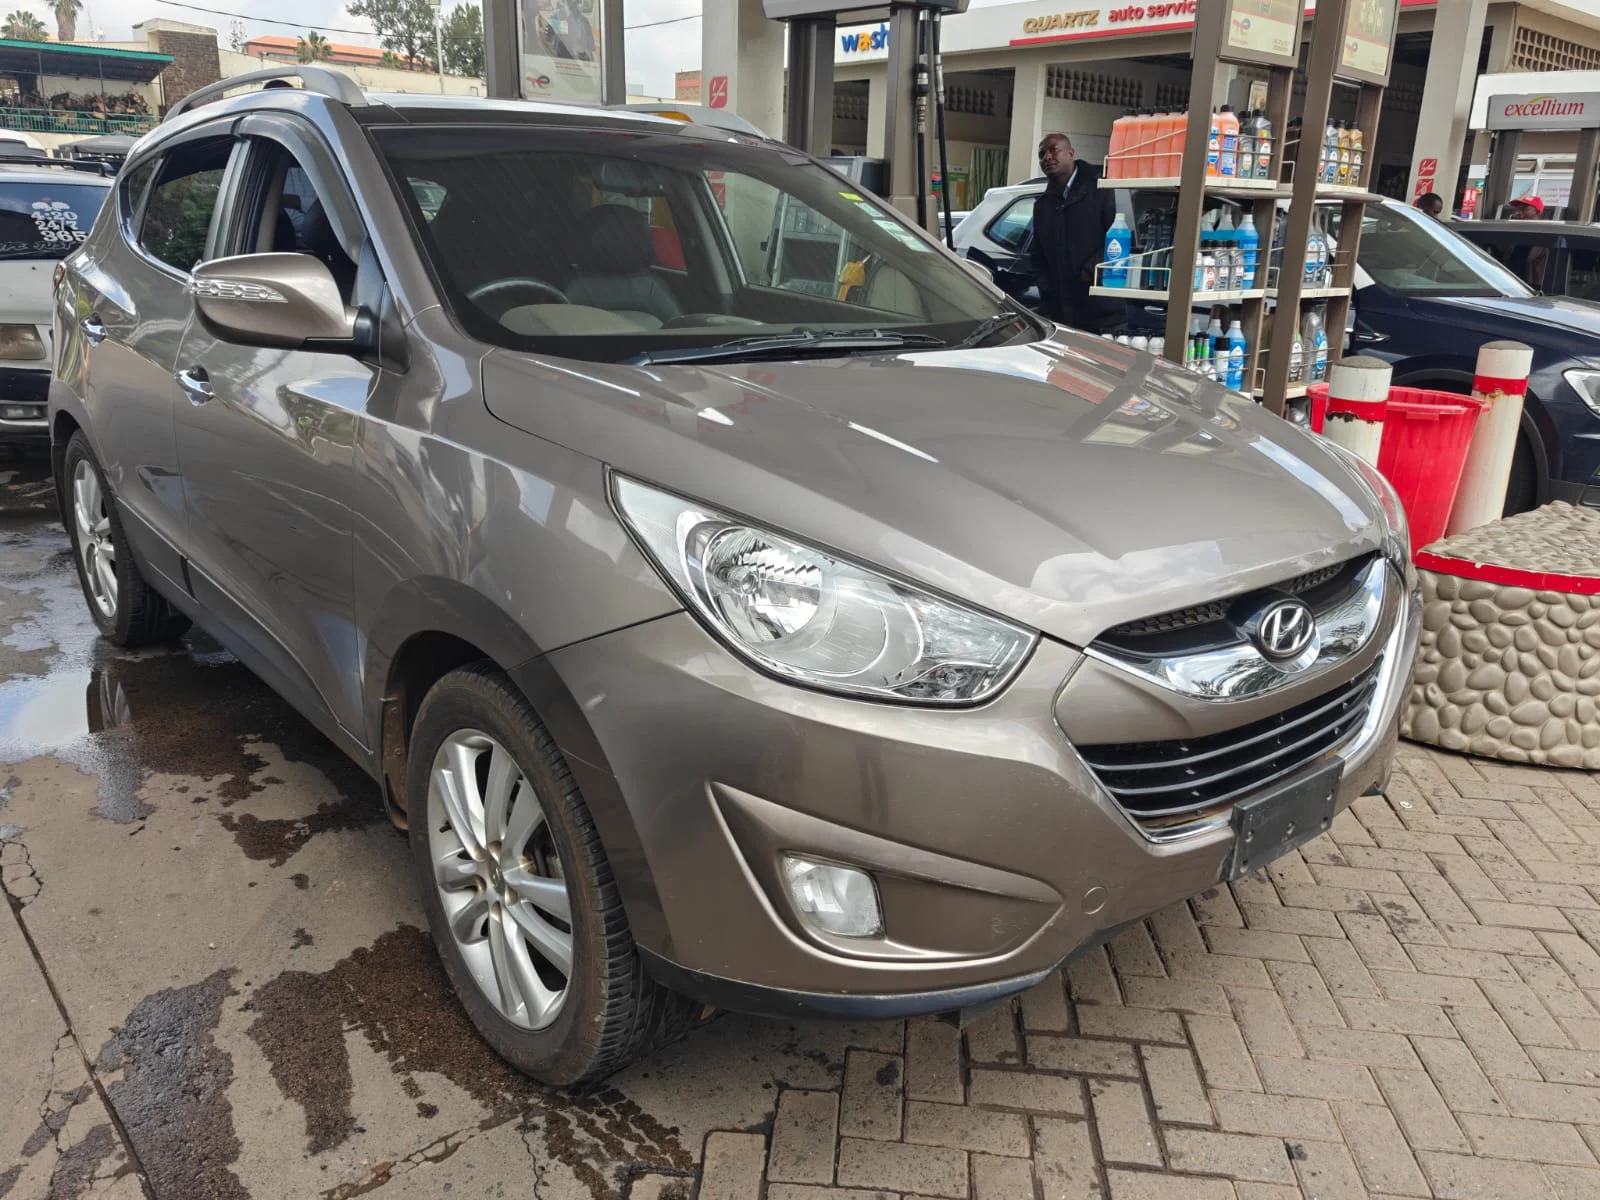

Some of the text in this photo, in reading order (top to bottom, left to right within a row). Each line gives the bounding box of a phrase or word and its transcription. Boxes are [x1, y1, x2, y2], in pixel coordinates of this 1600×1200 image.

[1023, 10, 1100, 33] QUARTZ
[1108, 6, 1144, 23] auto
[841, 23, 891, 53] wash
[1504, 99, 1584, 117] excellium
[31, 211, 78, 221] 4:20
[40, 230, 87, 242] 365
